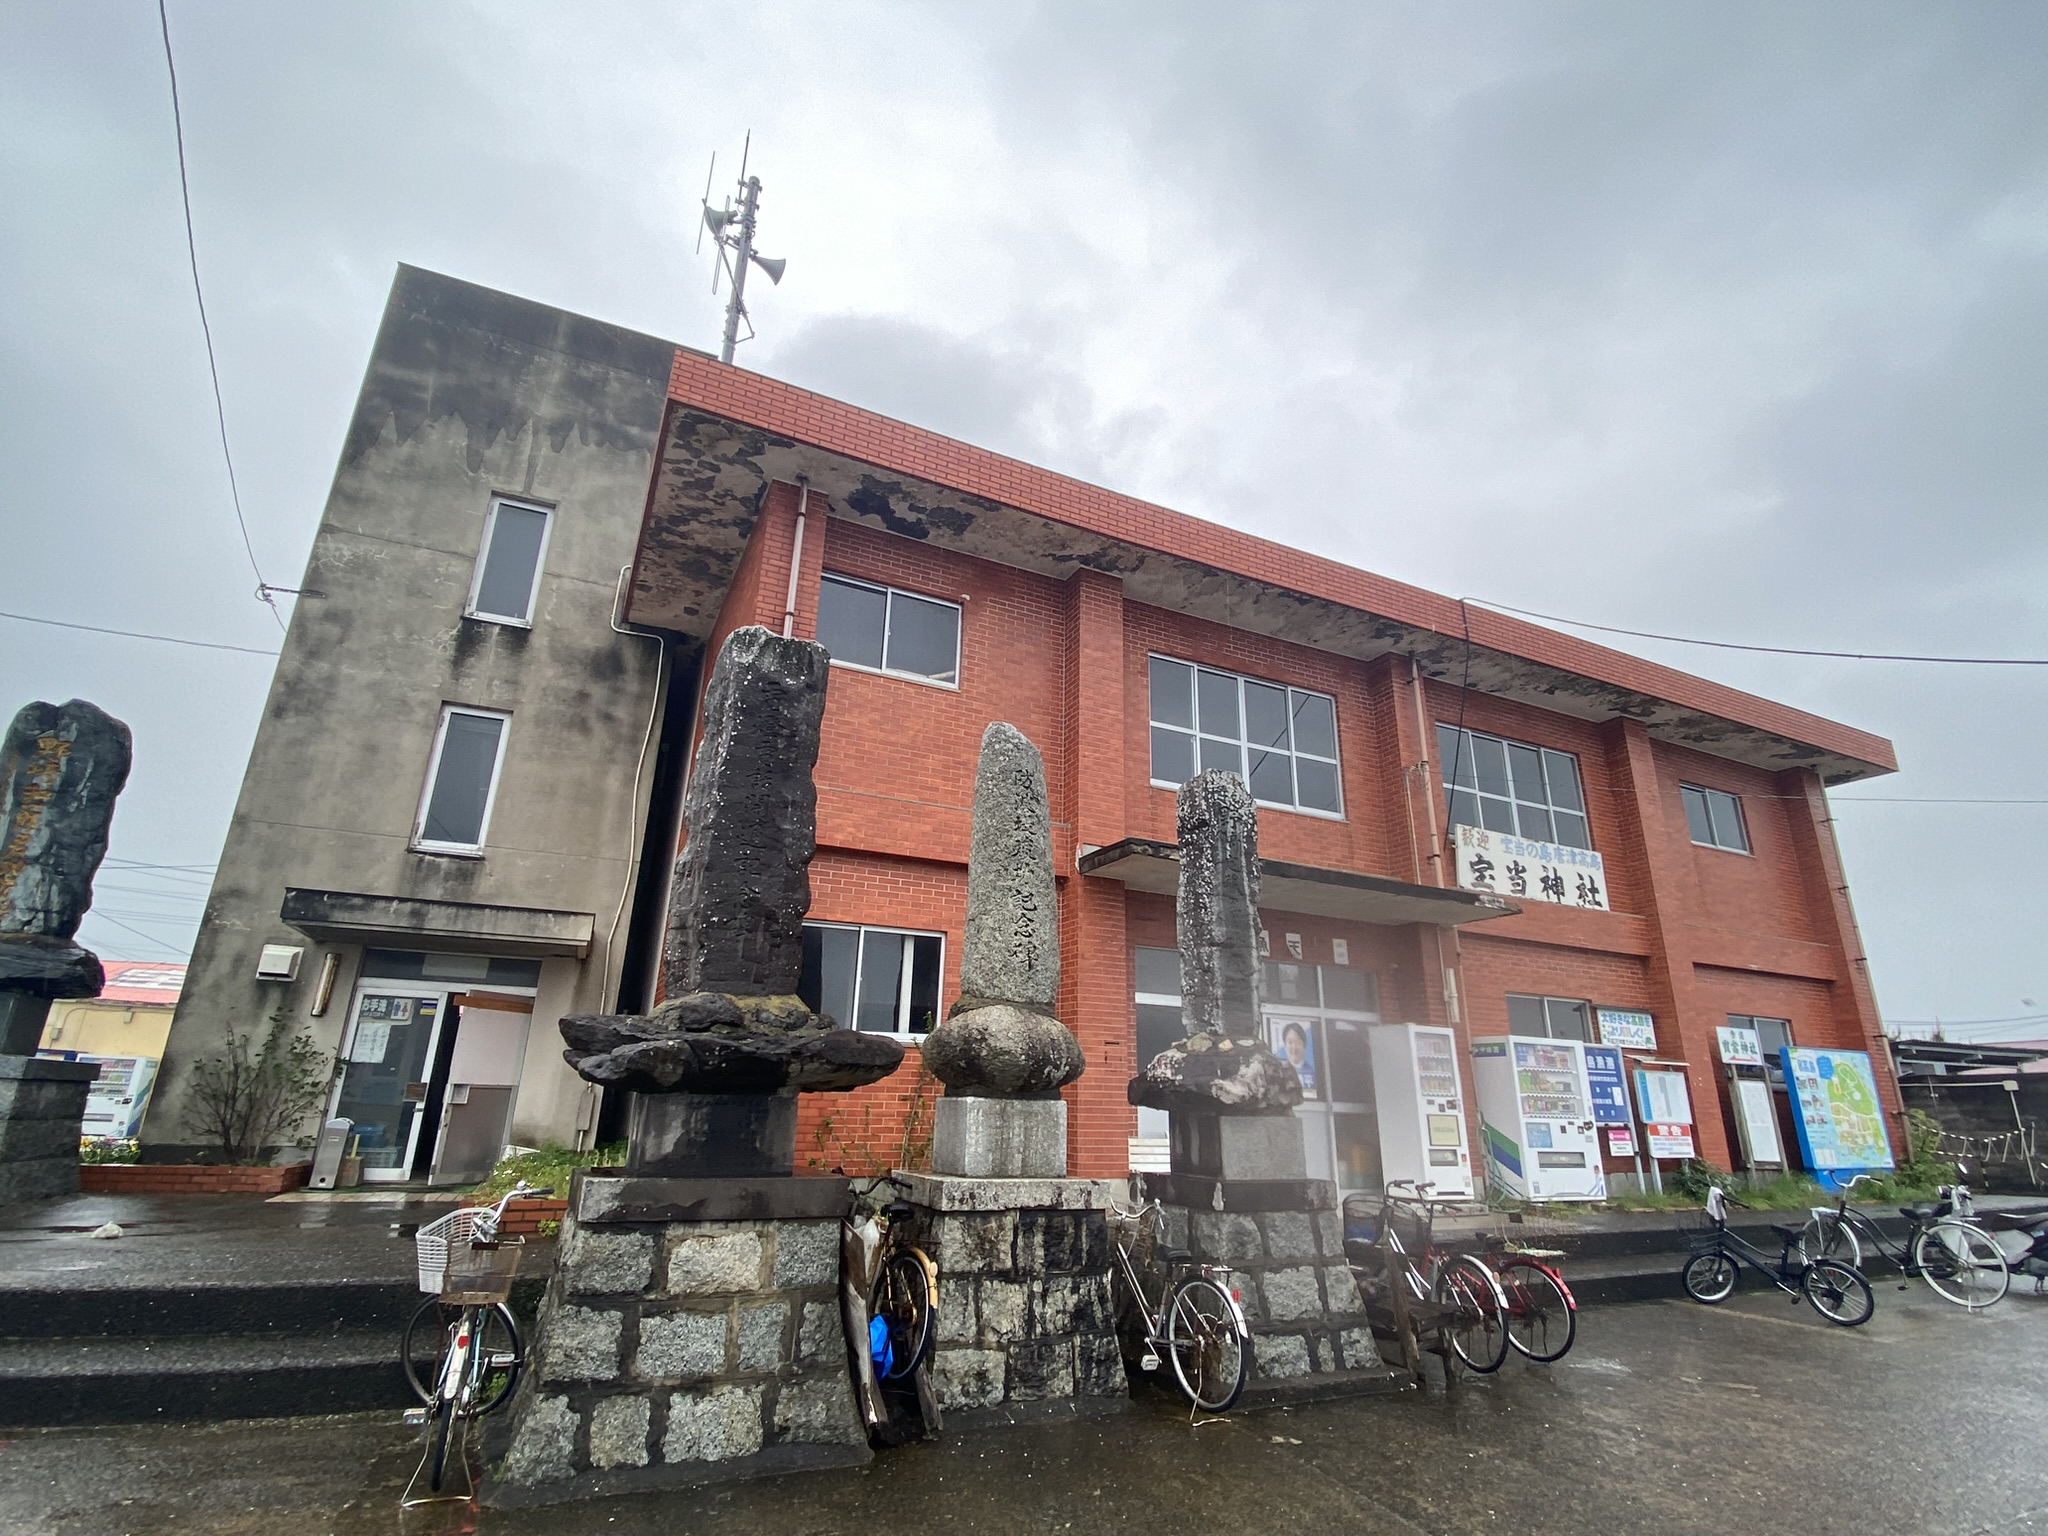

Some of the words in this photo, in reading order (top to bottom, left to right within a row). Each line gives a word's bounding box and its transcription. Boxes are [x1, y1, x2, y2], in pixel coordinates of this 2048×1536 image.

[1461, 826, 1490, 851] 歓迎
[1469, 852, 1603, 908] 宝当神社
[361, 998, 388, 1012] お手洗
